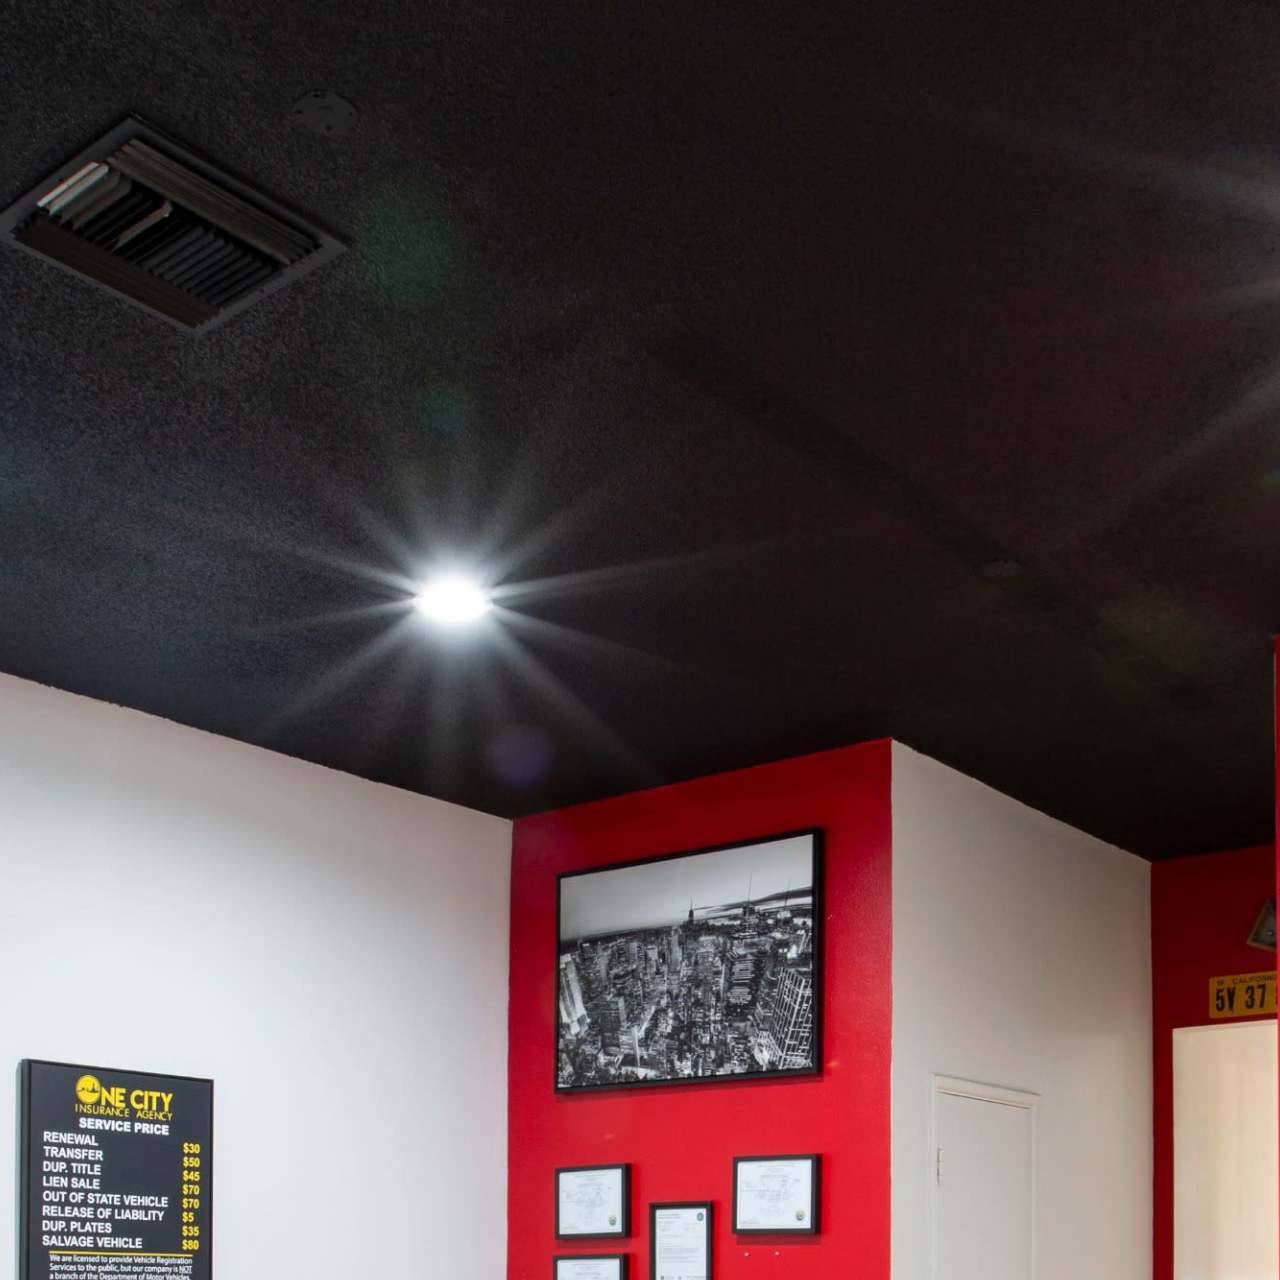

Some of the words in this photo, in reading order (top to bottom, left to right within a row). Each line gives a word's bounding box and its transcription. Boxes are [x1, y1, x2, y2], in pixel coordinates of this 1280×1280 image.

[130, 1090, 173, 1111] CITY
[75, 1104, 130, 1118] INSURANCE
[136, 1110, 173, 1121] AGENCY
[79, 1117, 131, 1132] SERVICE
[134, 1122, 169, 1136] PRICE
[43, 1131, 99, 1146] RENEWAL
[43, 1146, 104, 1161] TRANSFER
[43, 1160, 68, 1173] DUP.
[71, 1162, 101, 1175] TITLE
[43, 1176, 68, 1188] LIEN
[70, 1177, 100, 1189] SALE
[42, 1190, 67, 1202] OUT
[69, 1192, 85, 1203] OF
[87, 1193, 121, 1205] STATE
[123, 1195, 168, 1207] VEHICLE
[42, 1205, 94, 1218] RELEASE
[97, 1207, 112, 1219] OF
[114, 1209, 165, 1221] LIABILITY
[42, 1220, 67, 1232] DUP.
[70, 1221, 112, 1233] PLATES
[42, 1235, 94, 1247] SALVAGE
[96, 1236, 143, 1248] VEHICLE
[49, 1263, 76, 1271] Services
[86, 1264, 96, 1272] the
[97, 1264, 119, 1273] public,
[73, 1255, 99, 1263] licensed
[109, 1256, 133, 1265] provide
[134, 1256, 155, 1264] Vehicle
[157, 1257, 192, 1266] Registration
[55, 1272, 78, 1280] branch
[79, 1272, 86, 1280] of
[99, 1273, 137, 1280] Department
[138, 1273, 145, 1280] of
